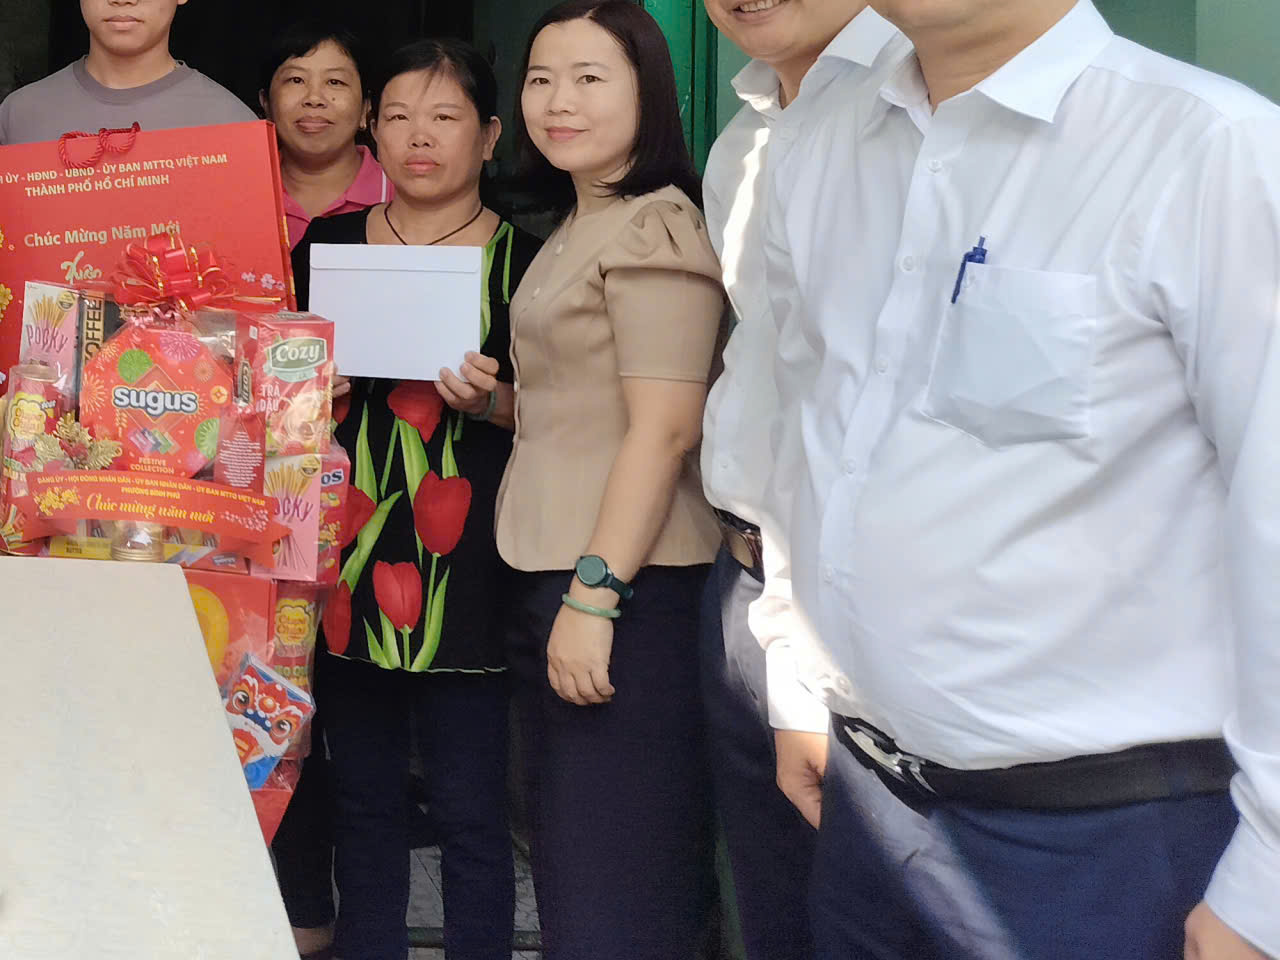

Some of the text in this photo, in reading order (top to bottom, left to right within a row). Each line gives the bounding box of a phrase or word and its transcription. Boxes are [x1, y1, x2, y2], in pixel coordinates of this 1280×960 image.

[27, 170, 58, 182] HĐND
[65, 167, 95, 178] UBND
[118, 162, 141, 173] BAN
[143, 159, 175, 170] MTTQ
[176, 155, 199, 168] VIỆT
[201, 154, 228, 165] NAM
[25, 174, 170, 197] THÀNH PHỐ HỒ CHÍ MINH
[24, 220, 180, 247] Chúc Mừng Năm Mới
[60, 250, 103, 285] Xuân
[84, 299, 102, 360] OFFEE
[275, 344, 320, 362] Cozy
[113, 386, 198, 417] sugus
[130, 464, 175, 474] COLLECTION
[86, 493, 216, 524] Chúc mừng năm mới
